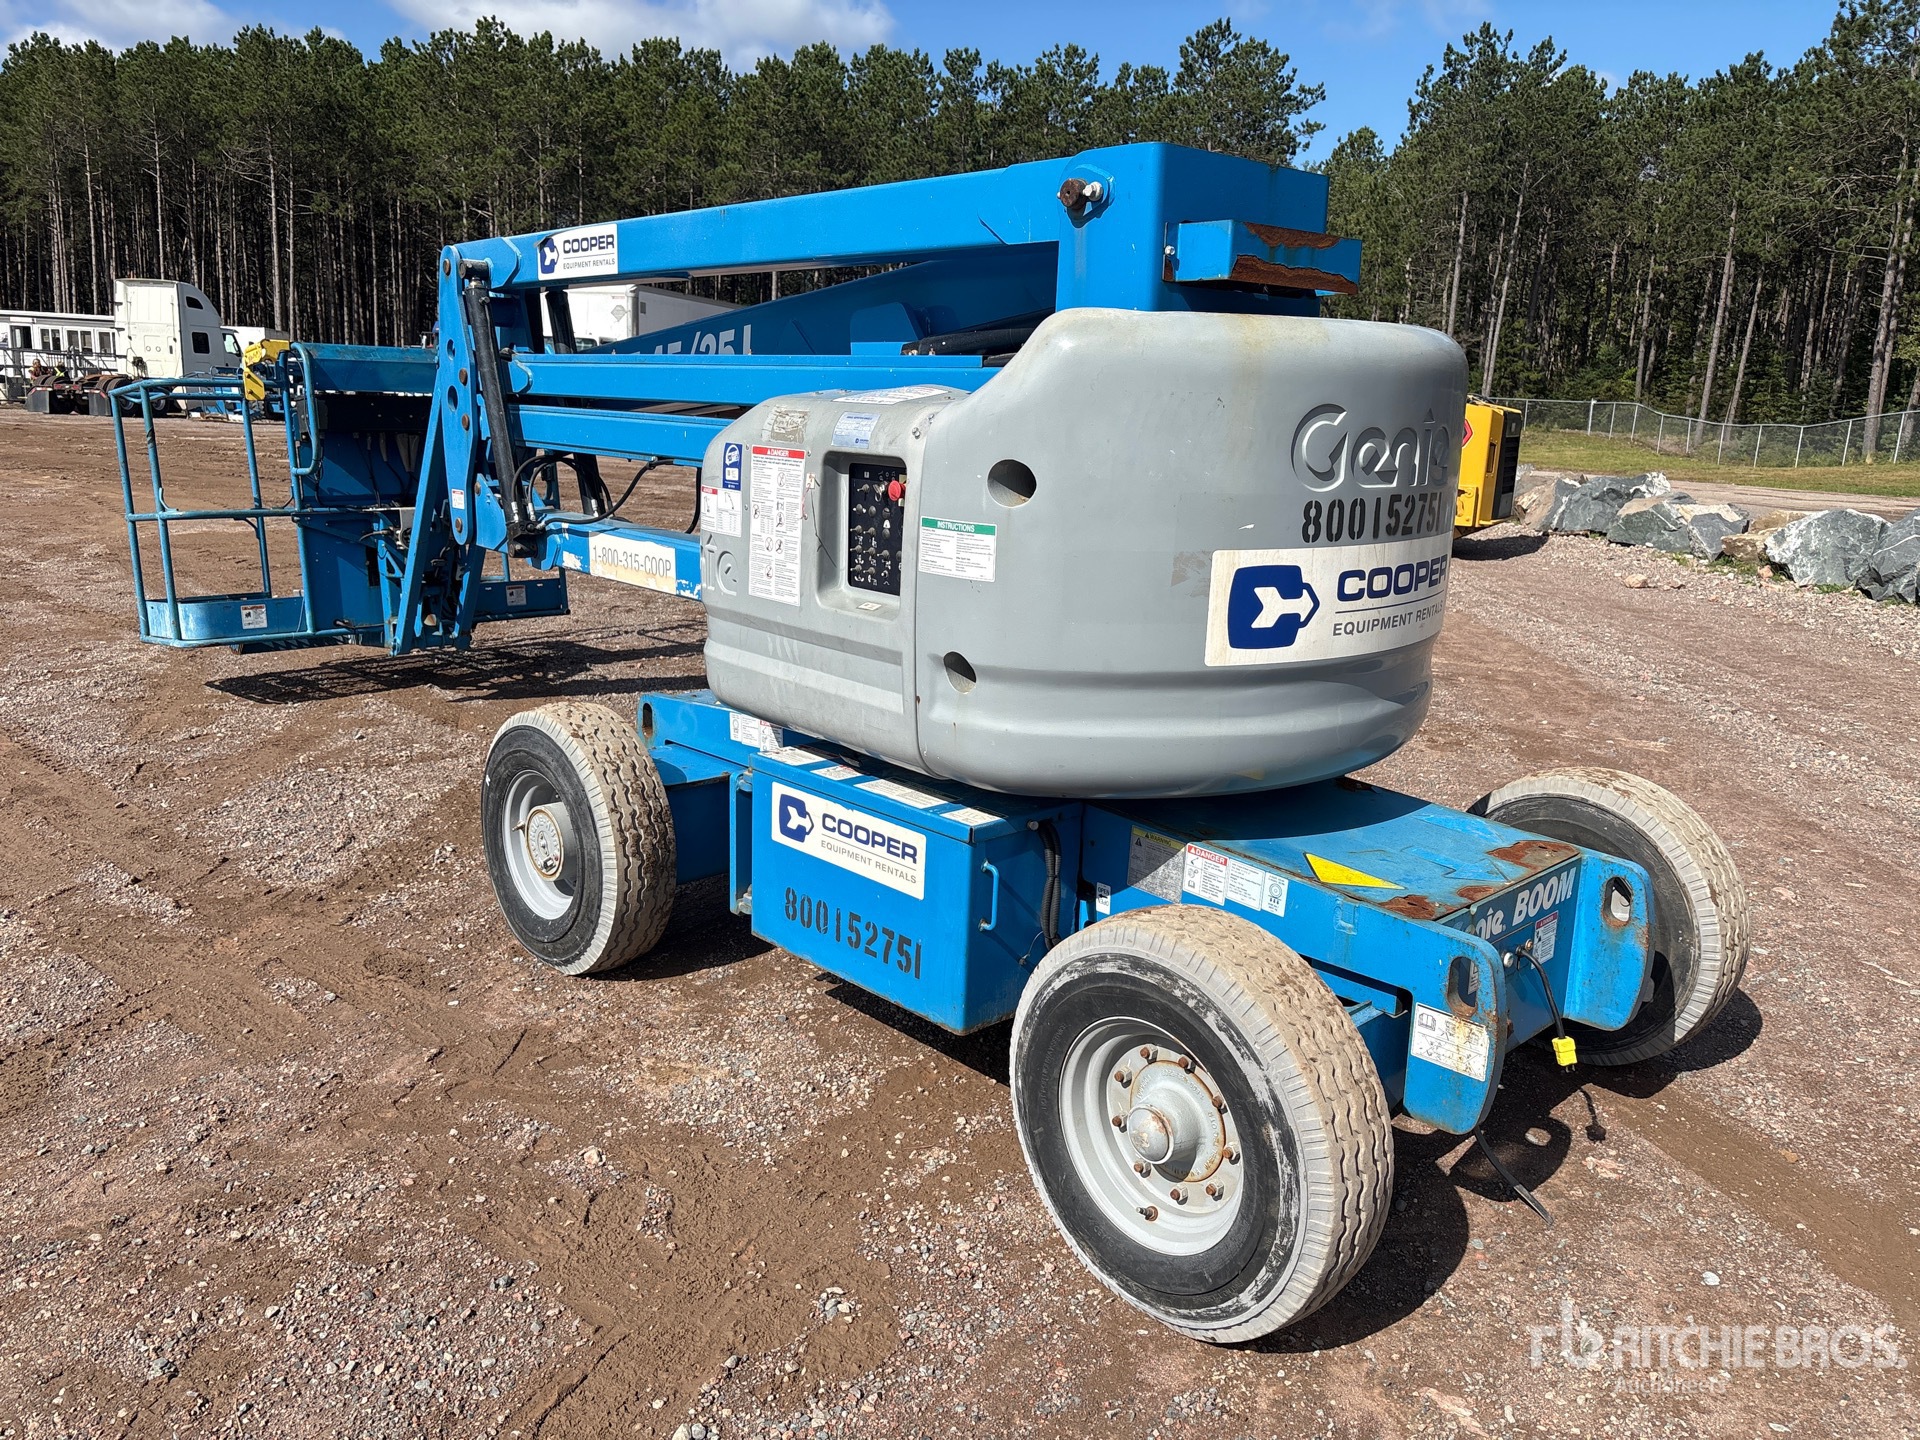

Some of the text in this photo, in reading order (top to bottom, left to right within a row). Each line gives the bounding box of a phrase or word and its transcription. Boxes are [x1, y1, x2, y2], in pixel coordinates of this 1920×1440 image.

[563, 234, 615, 254] COOPER
[563, 258, 615, 270] EQUIPMENT RENTALS
[770, 448, 790, 458] DANGER
[1291, 403, 1450, 492] Genie
[937, 520, 975, 533] INSTRUCTIONS
[1301, 492, 1442, 543] 800152751
[592, 545, 672, 578] 1-800-315-COOP
[1336, 554, 1448, 602] COOPER
[1333, 599, 1444, 636] EQUIPMENT RENTALS
[822, 813, 917, 864] COOPER
[1195, 847, 1225, 865] DANGER
[821, 840, 917, 884] EQUIPMENT RENTALS
[1512, 866, 1577, 926] BOOM
[785, 887, 922, 979] 800152751
